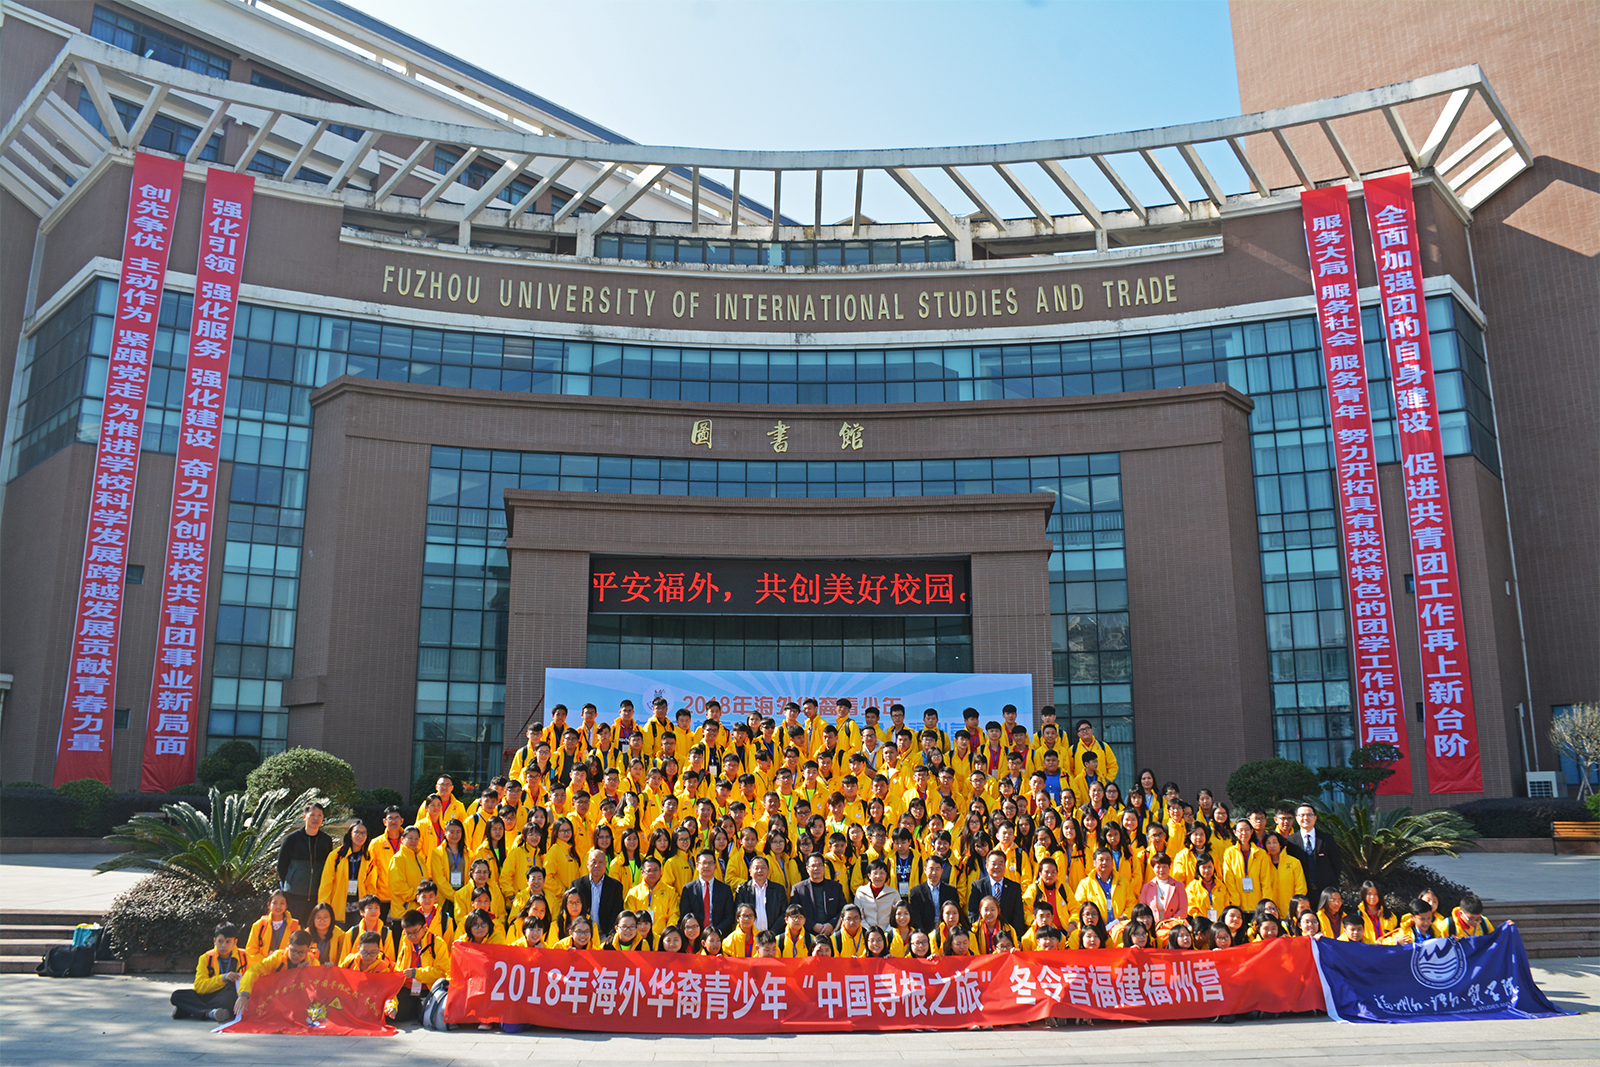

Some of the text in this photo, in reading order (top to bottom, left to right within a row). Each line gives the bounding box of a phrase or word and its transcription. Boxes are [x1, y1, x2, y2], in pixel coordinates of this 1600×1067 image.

[131, 184, 172, 251] 创先争优
[120, 257, 160, 324] 主动作为
[382, 265, 1178, 322] FUZHOU UNIVERSITY OF INTERNATIONAL STUDIES AND TRADE
[690, 418, 865, 454] 圖書館
[154, 198, 243, 756] 强化引领 强化服务 强化建设 奋力开创我校共青团事业新局面
[1312, 214, 1400, 760] 服务大局 服务社会 服务青年 努力开拓具有我校特色的团学工作的新局
[1375, 204, 1470, 758] 全面加强团的自身建设 促进共青团工作再上新台阶
